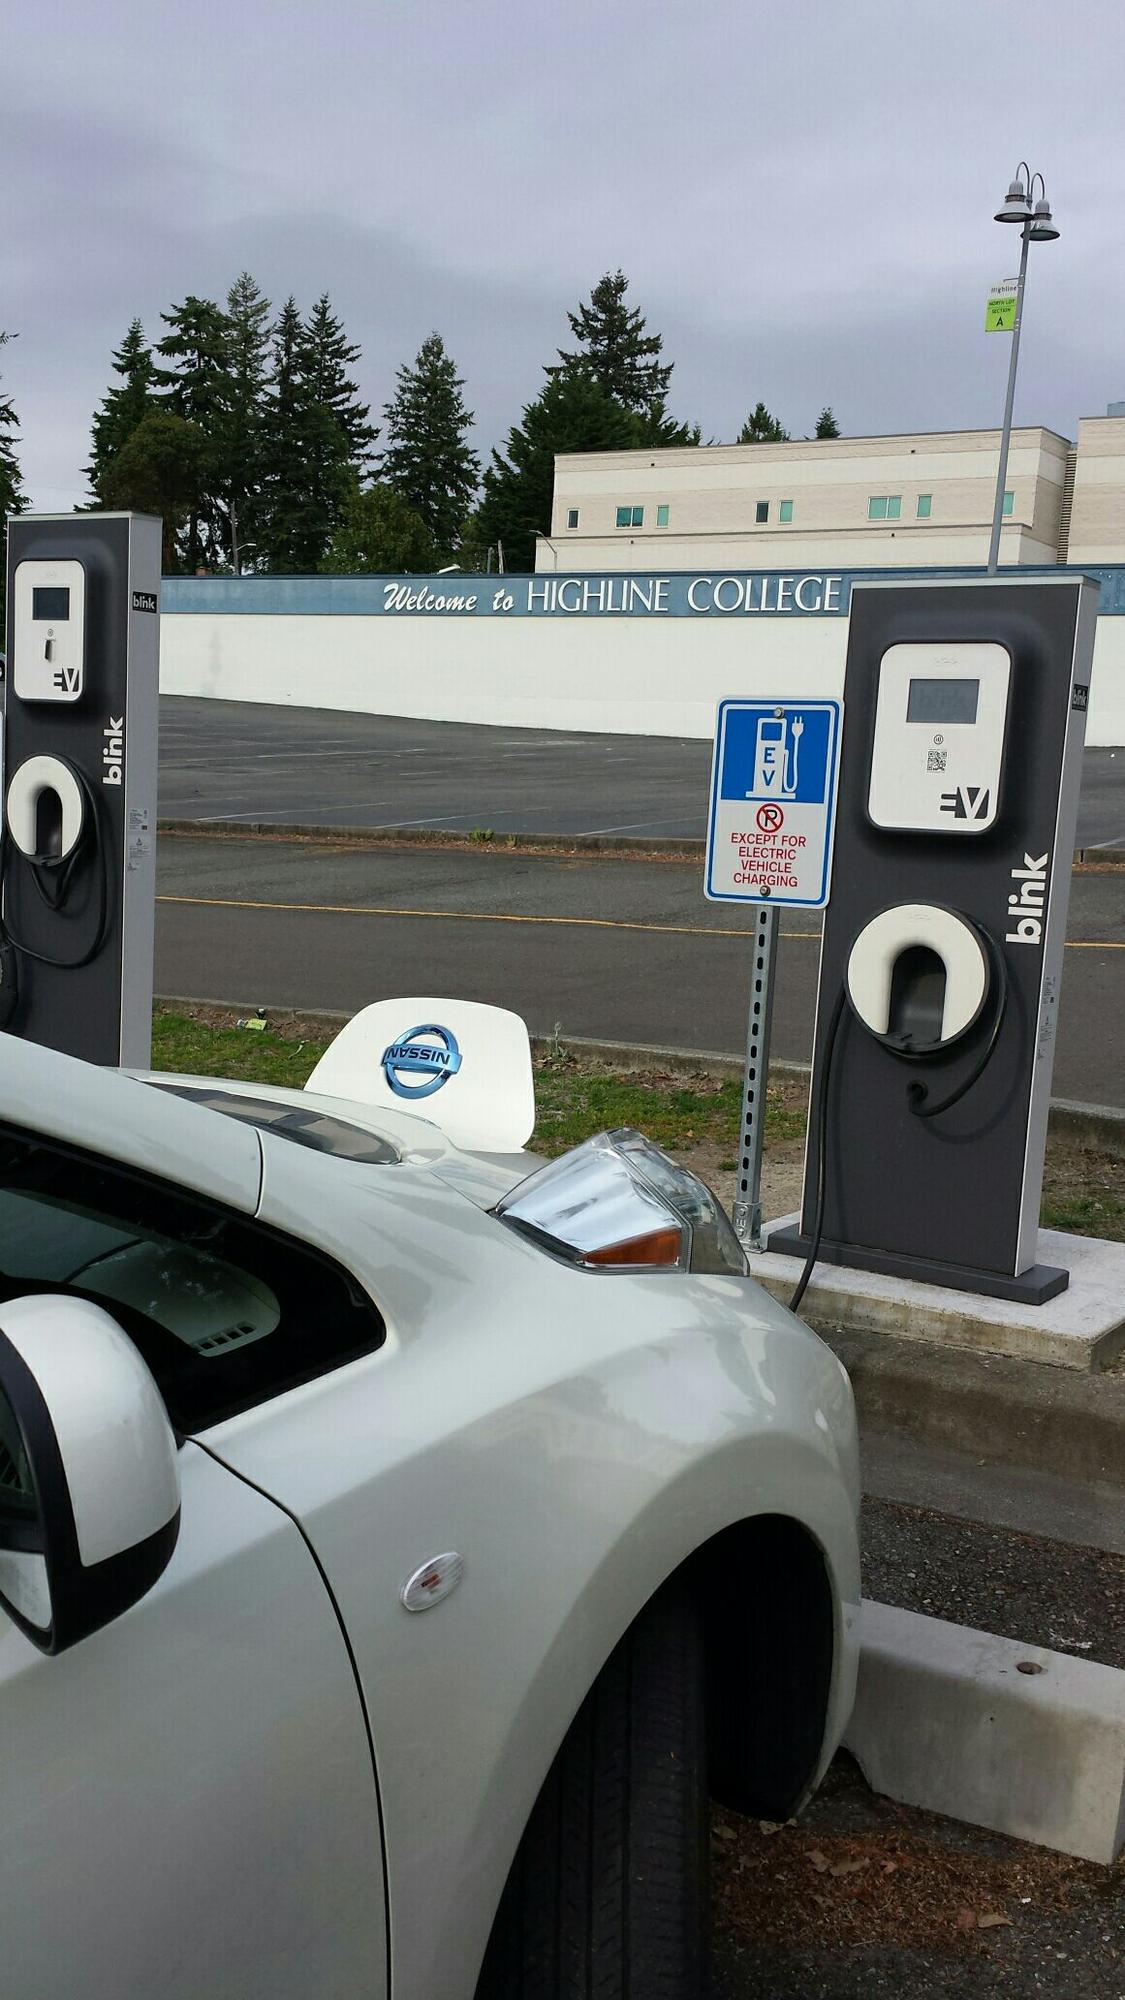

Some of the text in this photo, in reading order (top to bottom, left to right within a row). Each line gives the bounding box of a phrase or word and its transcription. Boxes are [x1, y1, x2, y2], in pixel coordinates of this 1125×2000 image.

[996, 316, 1004, 327] A
[383, 577, 842, 612] Welcome to HIGHLINE COLLEGE
[133, 596, 155, 609] blink
[102, 716, 124, 786] blink
[731, 832, 807, 847] EXCEPT FOR
[738, 847, 796, 860] ELECTRIC
[741, 860, 792, 874] VEHICLE
[733, 872, 798, 888] CHARGING
[1005, 852, 1049, 945] blink
[386, 1047, 451, 1064] NISSAN
